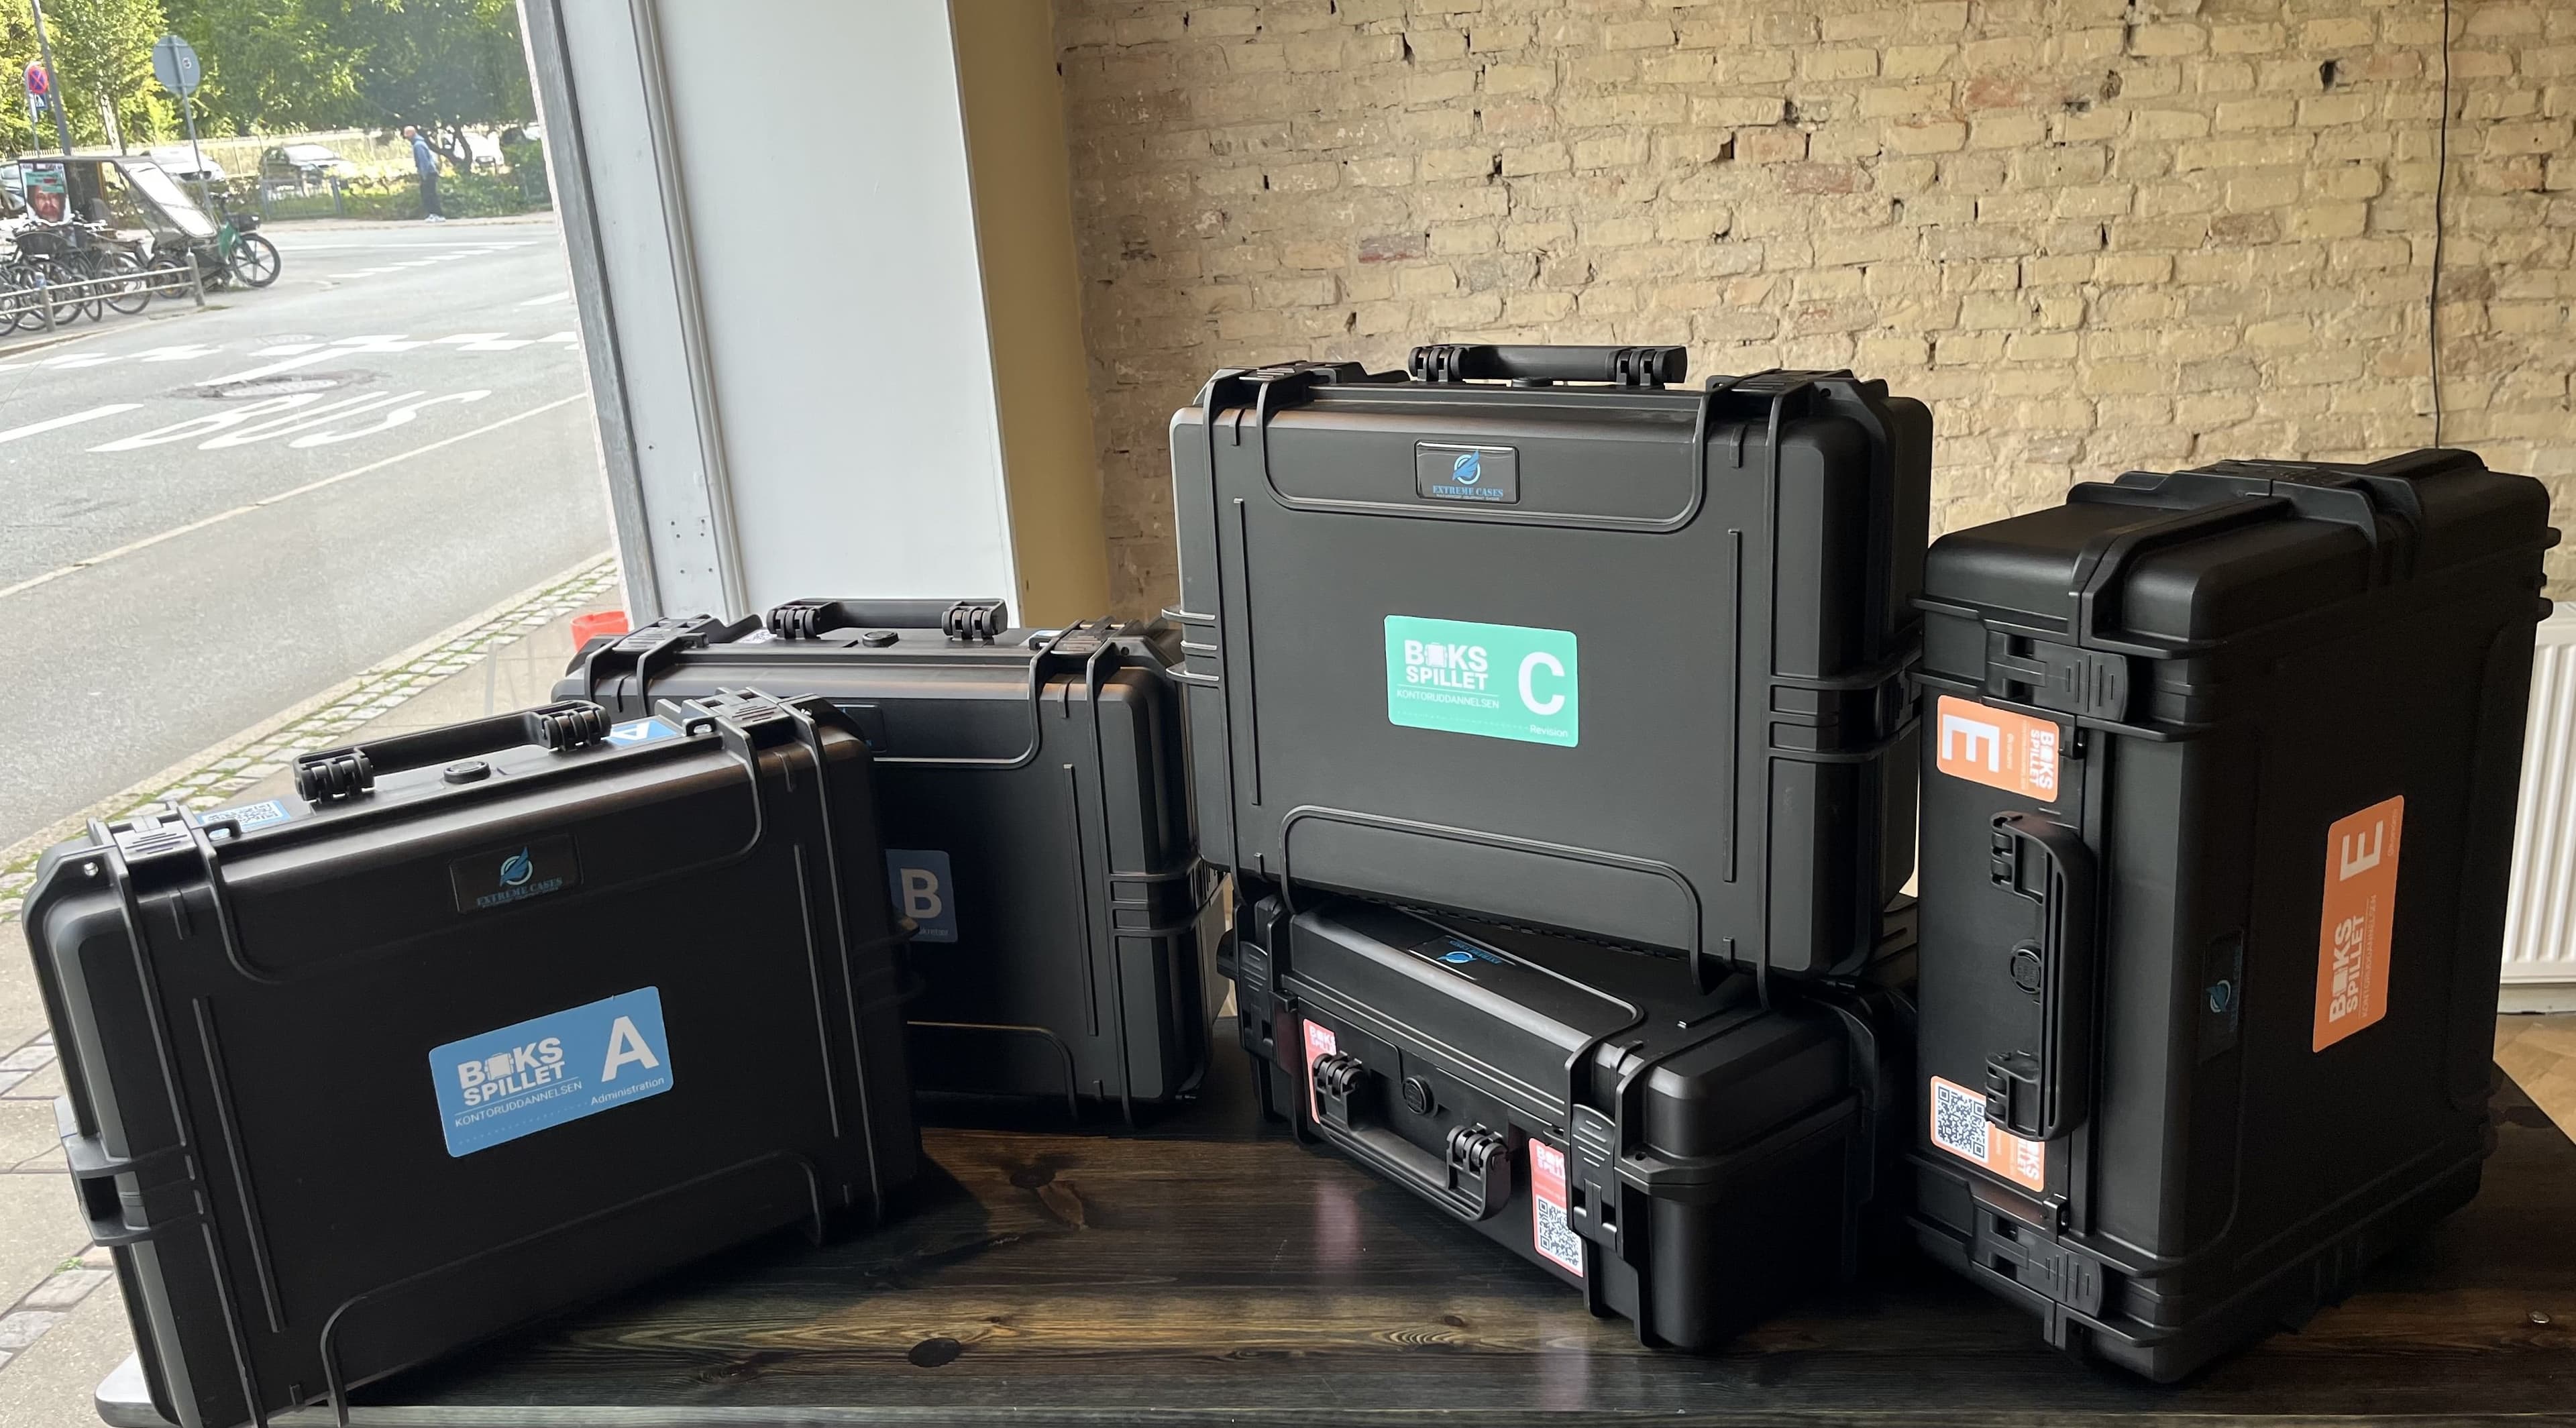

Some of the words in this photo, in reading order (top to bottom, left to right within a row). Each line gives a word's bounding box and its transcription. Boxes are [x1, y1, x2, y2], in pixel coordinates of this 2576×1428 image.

[1432, 485, 1474, 496] EXTREME
[1476, 488, 1504, 498] CASES
[1397, 689, 1500, 709] KONTORUDDANNELSEN
[1406, 665, 1489, 690] SPILLET
[1518, 651, 1565, 715] C
[1529, 724, 1568, 738] Revision
[1941, 714, 2000, 773] E
[2029, 729, 2041, 786] SPILLET
[2339, 820, 2384, 882] E
[476, 886, 527, 906] EXTREME
[529, 877, 564, 892] CASES
[900, 868, 942, 918] B
[2346, 914, 2365, 1014] SPILLET
[601, 1015, 659, 1083] A
[455, 1081, 582, 1128] KONTORUDDANNELSEN
[463, 1061, 565, 1106] SPILLET
[590, 1077, 665, 1106] Administration
